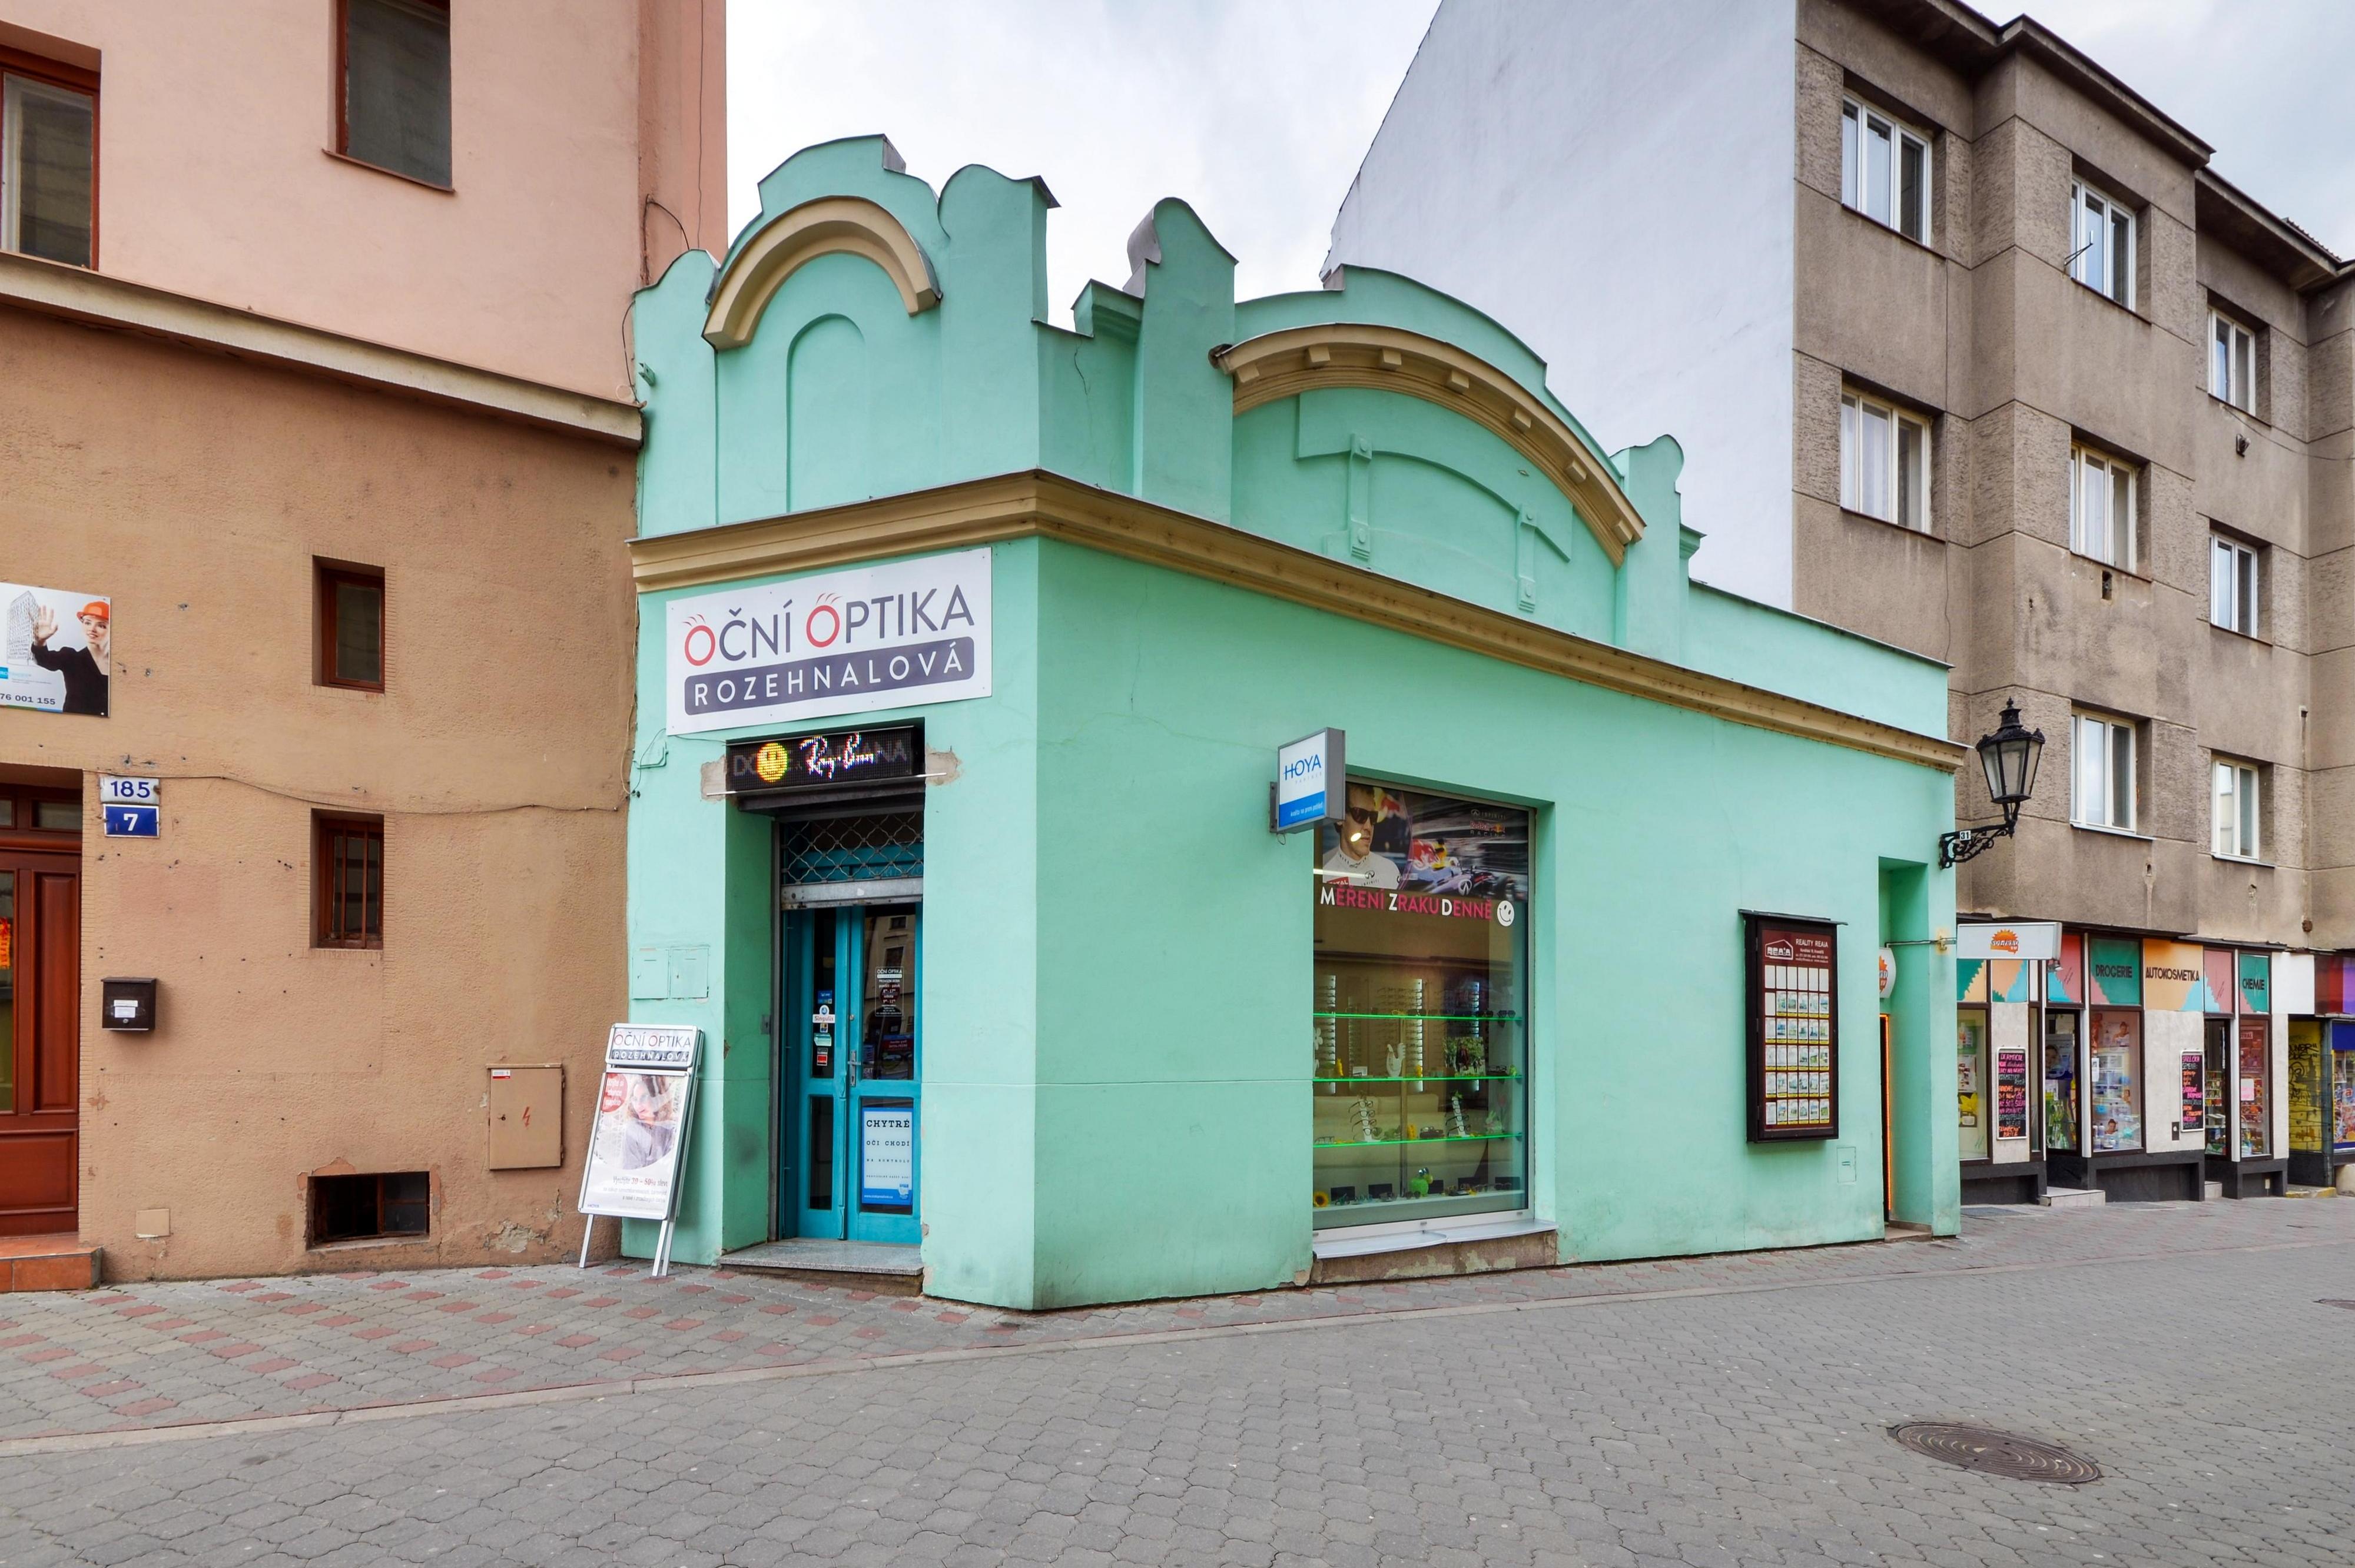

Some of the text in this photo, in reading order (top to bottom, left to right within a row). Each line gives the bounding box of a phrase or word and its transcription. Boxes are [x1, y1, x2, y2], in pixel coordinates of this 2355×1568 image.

[684, 584, 974, 666] OČNÍ OPTIKA
[695, 642, 963, 706] ROZEHNALOVÁ
[1283, 754, 1322, 780] HOYA
[111, 780, 150, 798] 185
[124, 813, 138, 831] 7
[1961, 832, 1969, 840] 31
[1321, 884, 1492, 921] MĚŘENÍ ZRAKU DENNĚ
[2095, 965, 2132, 978] DROGERIE
[2145, 967, 2200, 982] AUTOKOSMETIKA
[2242, 978, 2265, 990] CHEMIE
[613, 1032, 691, 1047] OČNÍ OPTIKA
[866, 1119, 910, 1128] CHYTRÉ
